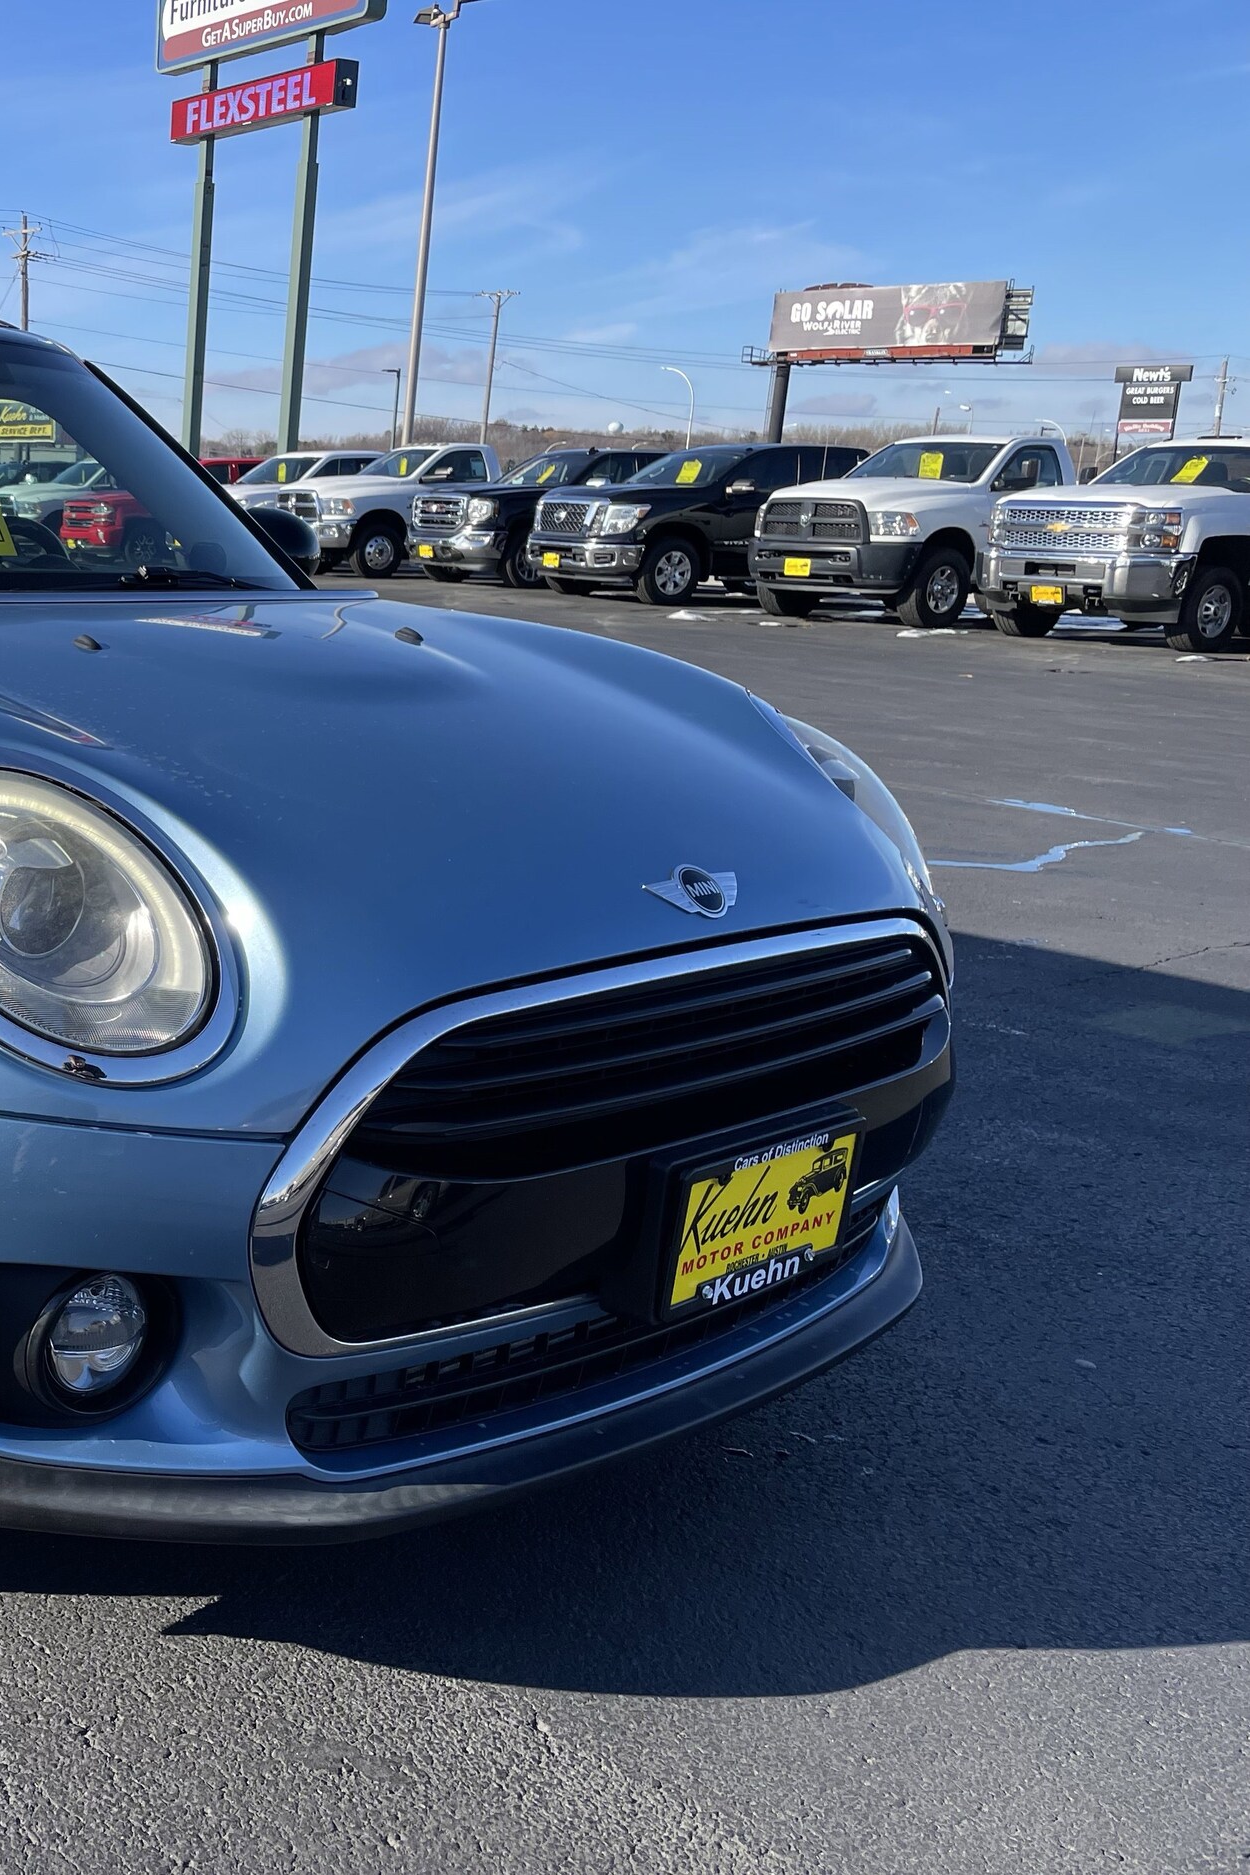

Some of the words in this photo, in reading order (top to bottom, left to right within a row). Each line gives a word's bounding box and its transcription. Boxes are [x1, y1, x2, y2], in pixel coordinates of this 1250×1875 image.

[170, 0, 247, 25] Furnitu
[186, 72, 316, 134] FLEXSTEEL
[791, 302, 812, 323] GO
[816, 300, 874, 321] SOLAR
[803, 321, 829, 331] WOLF
[833, 320, 862, 329] RIVER
[1132, 366, 1171, 382] Newt's
[1125, 387, 1145, 395] GREAT
[1146, 386, 1174, 395] BURGERS
[1132, 396, 1149, 404] COLD
[1150, 396, 1165, 404] BEER
[1, 427, 28, 435] SERVICE
[686, 881, 720, 898] MINI
[734, 1156, 760, 1172] Cars
[761, 1147, 774, 1163] of
[774, 1133, 829, 1158] Distinction
[679, 1165, 778, 1255] Kuehn
[681, 1242, 744, 1276] MOTOR
[751, 1210, 835, 1249] COMPANY
[726, 1253, 760, 1274] ROCHESTER
[767, 1242, 788, 1260] AUSTIN
[712, 1256, 800, 1305] Kuehn
